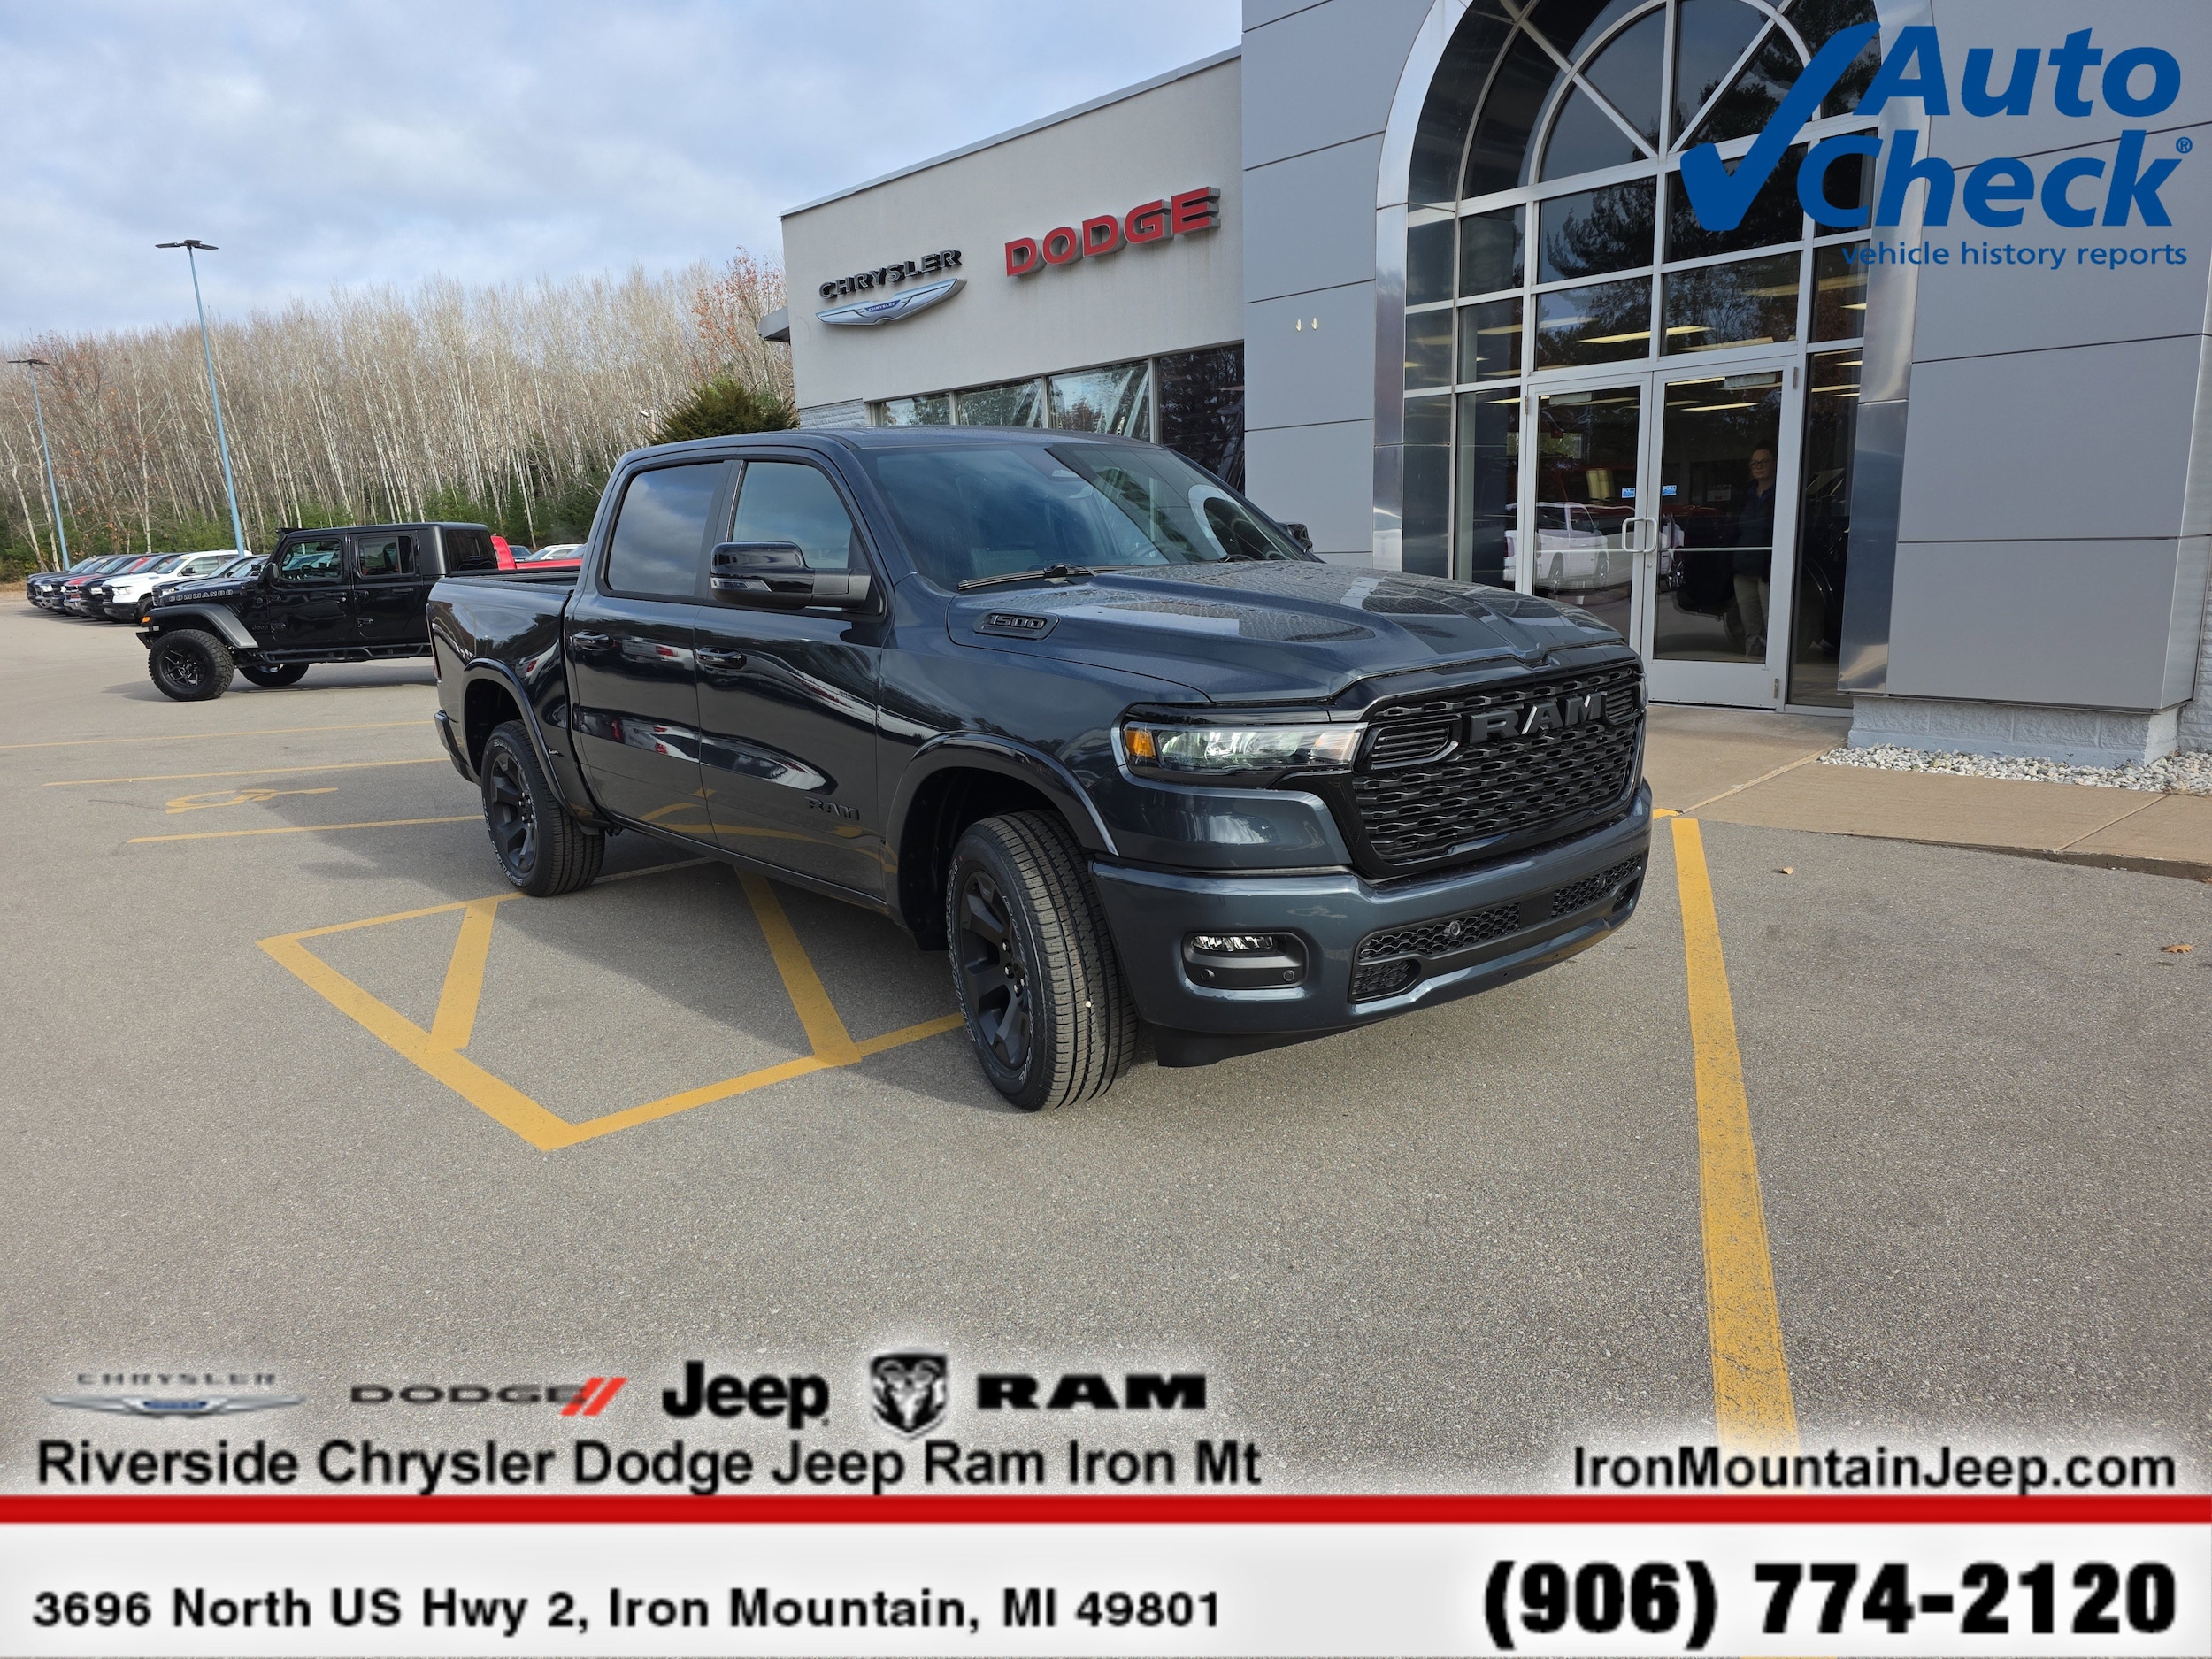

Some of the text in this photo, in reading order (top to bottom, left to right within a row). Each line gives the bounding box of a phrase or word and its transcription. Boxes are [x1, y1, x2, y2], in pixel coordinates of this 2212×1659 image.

[1004, 186, 1221, 278] DODGE
[818, 249, 963, 300] CHRYSLER
[168, 588, 234, 603] COMMANDO
[990, 614, 1045, 629] 1500
[1468, 691, 1608, 744] RAM
[804, 795, 861, 822] RAM
